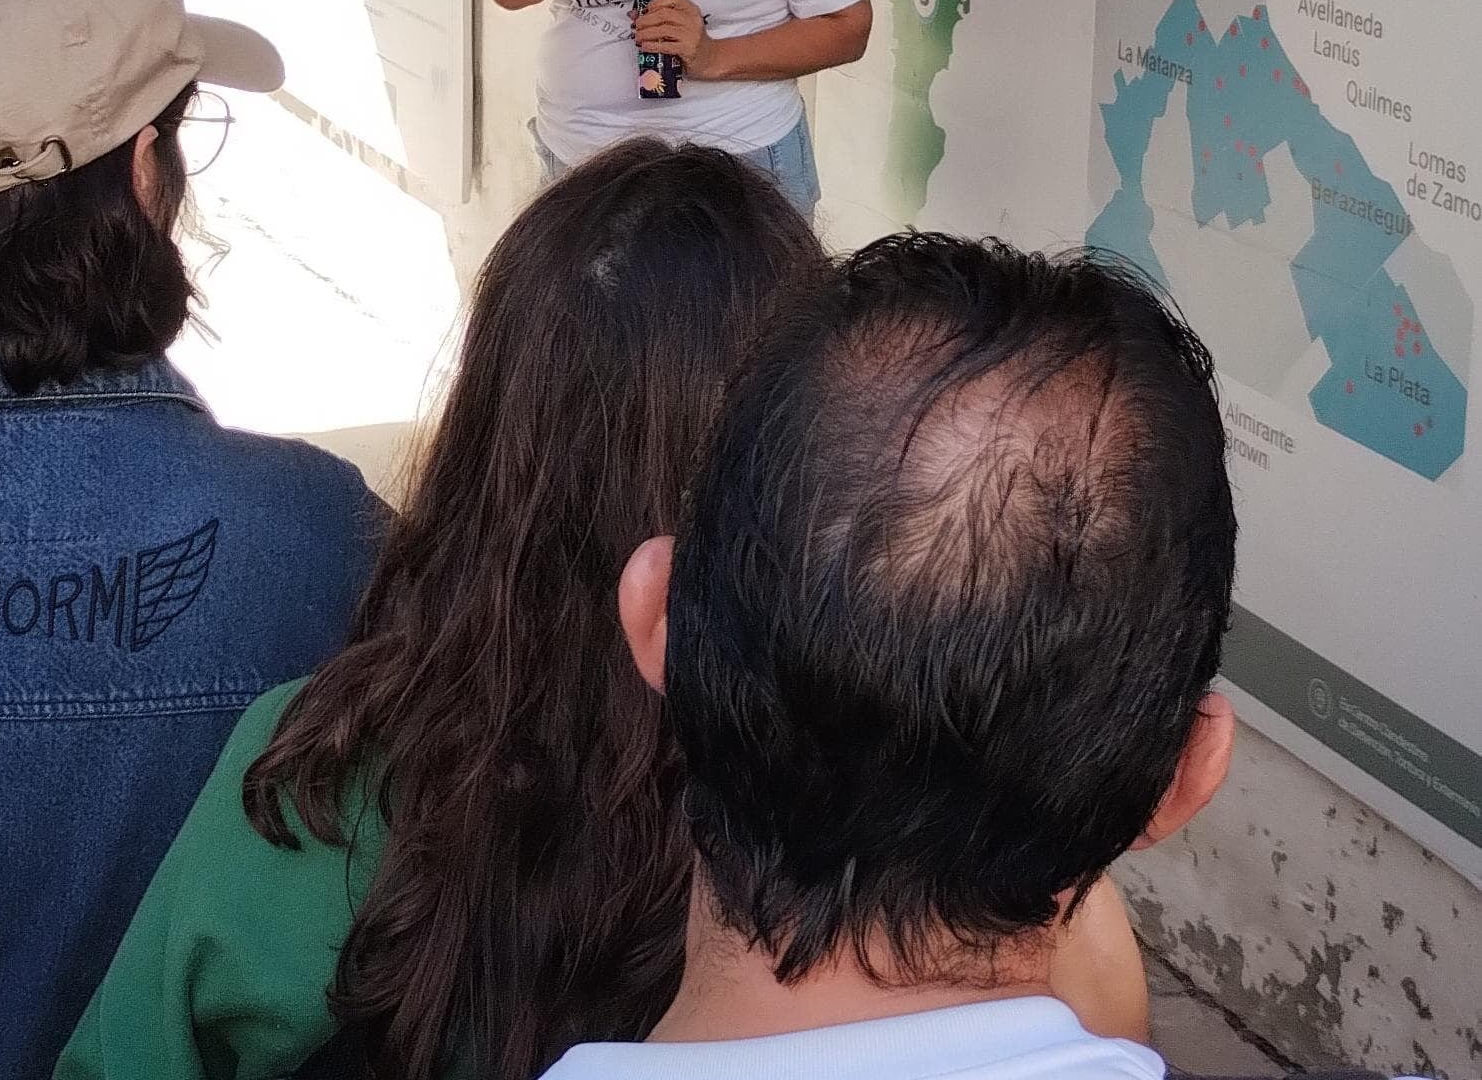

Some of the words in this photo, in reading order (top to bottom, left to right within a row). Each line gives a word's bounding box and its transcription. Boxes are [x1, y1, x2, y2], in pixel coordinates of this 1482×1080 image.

[1118, 37, 1133, 63] La
[1136, 45, 1193, 85] Matanza
[1313, 30, 1361, 68] Lanús
[1346, 79, 1413, 123] Quilmes
[1408, 140, 1467, 184] Lomas
[1311, 175, 1415, 238] Berazategui
[1406, 172, 1427, 201] de
[1431, 181, 1482, 221] Zamo
[1364, 356, 1383, 384] La
[1387, 366, 1431, 407] Plata
[1223, 427, 1268, 471] Brown
[1224, 401, 1294, 455] Almirante
